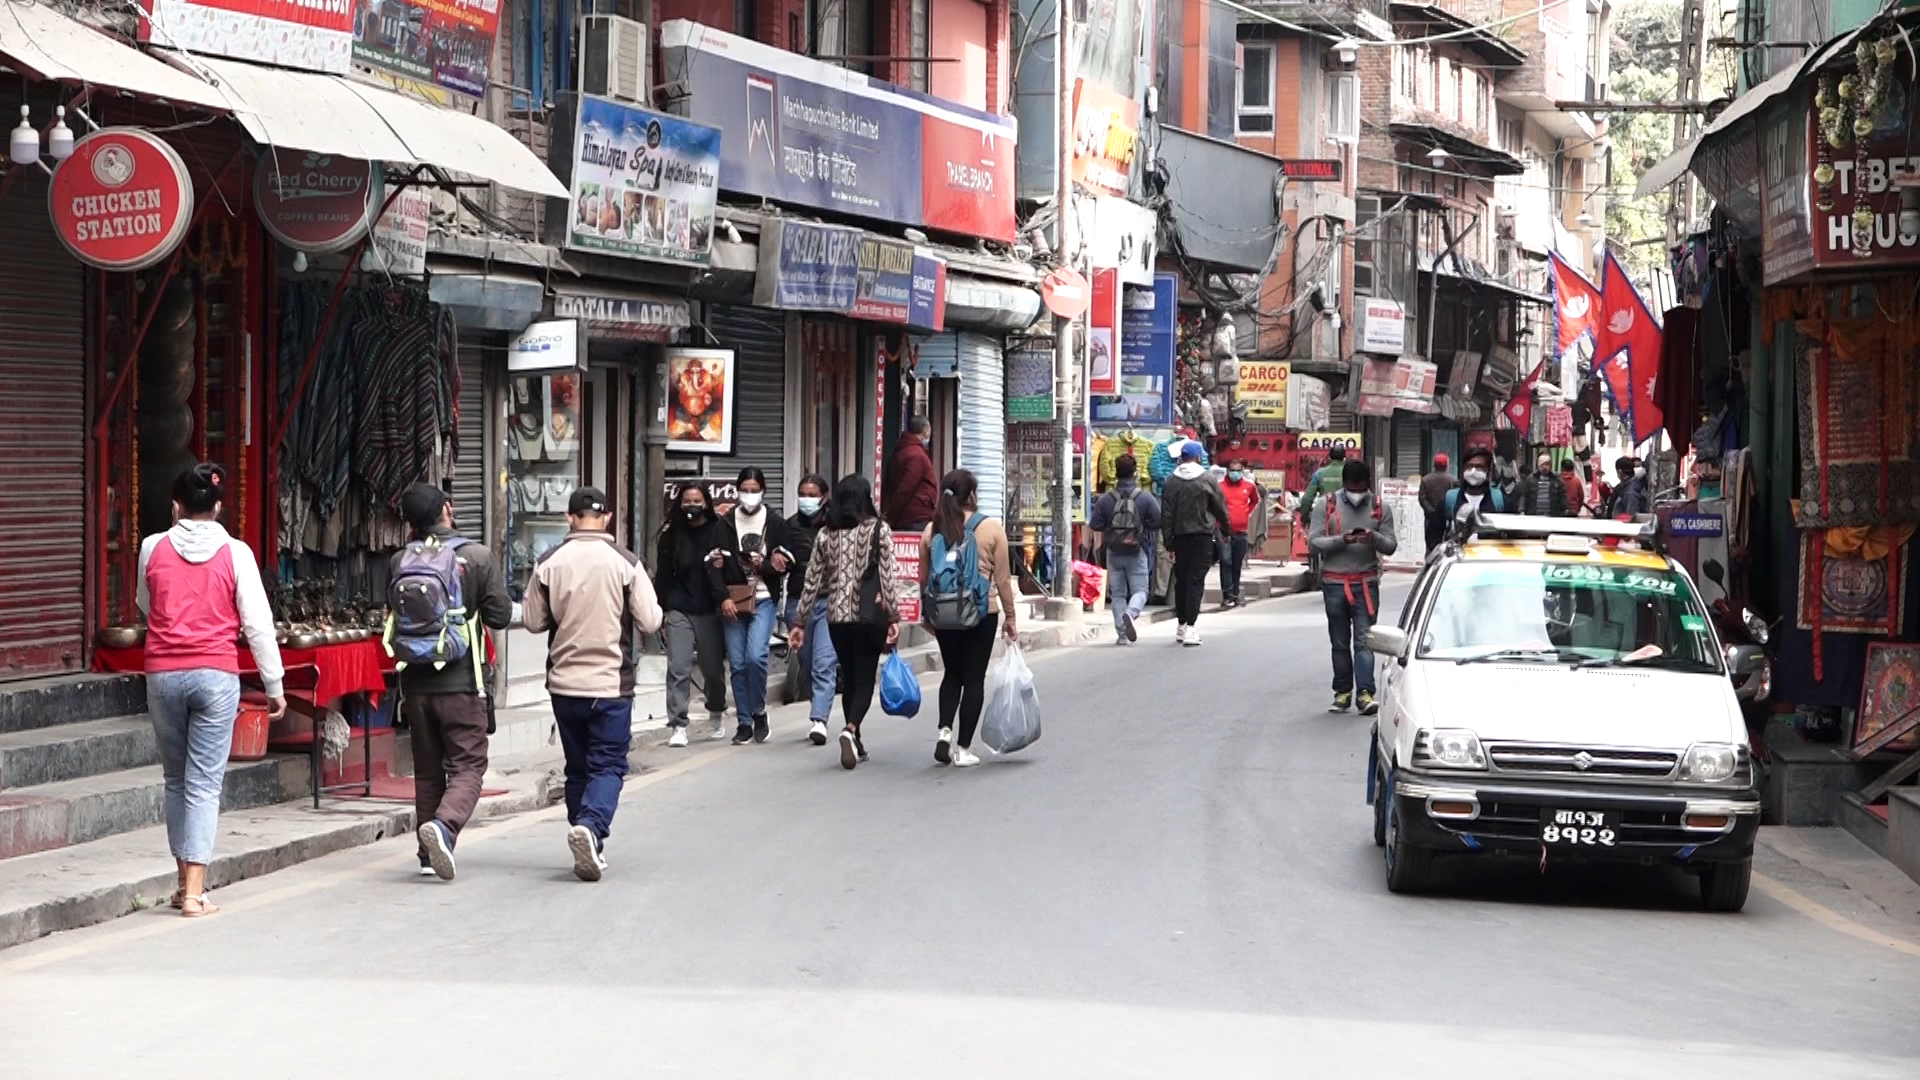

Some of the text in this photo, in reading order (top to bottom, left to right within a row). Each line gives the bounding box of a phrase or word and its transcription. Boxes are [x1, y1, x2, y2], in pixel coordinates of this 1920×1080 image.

[581, 134, 627, 177] Himalayan
[630, 145, 655, 184] Spa
[268, 171, 362, 187] Red Cherry
[72, 189, 161, 217] CHICKEN
[277, 212, 350, 222] COFFEE BEANS
[76, 213, 161, 241] STATION
[641, 303, 689, 326] ARTS
[1240, 365, 1288, 381] CARGO
[1259, 400, 1283, 408] PARCEL
[1300, 437, 1357, 448] CARGO
[873, 417, 884, 511] EXCHANG
[1688, 518, 1721, 530] CASHMERE
[1625, 572, 1677, 594] you
